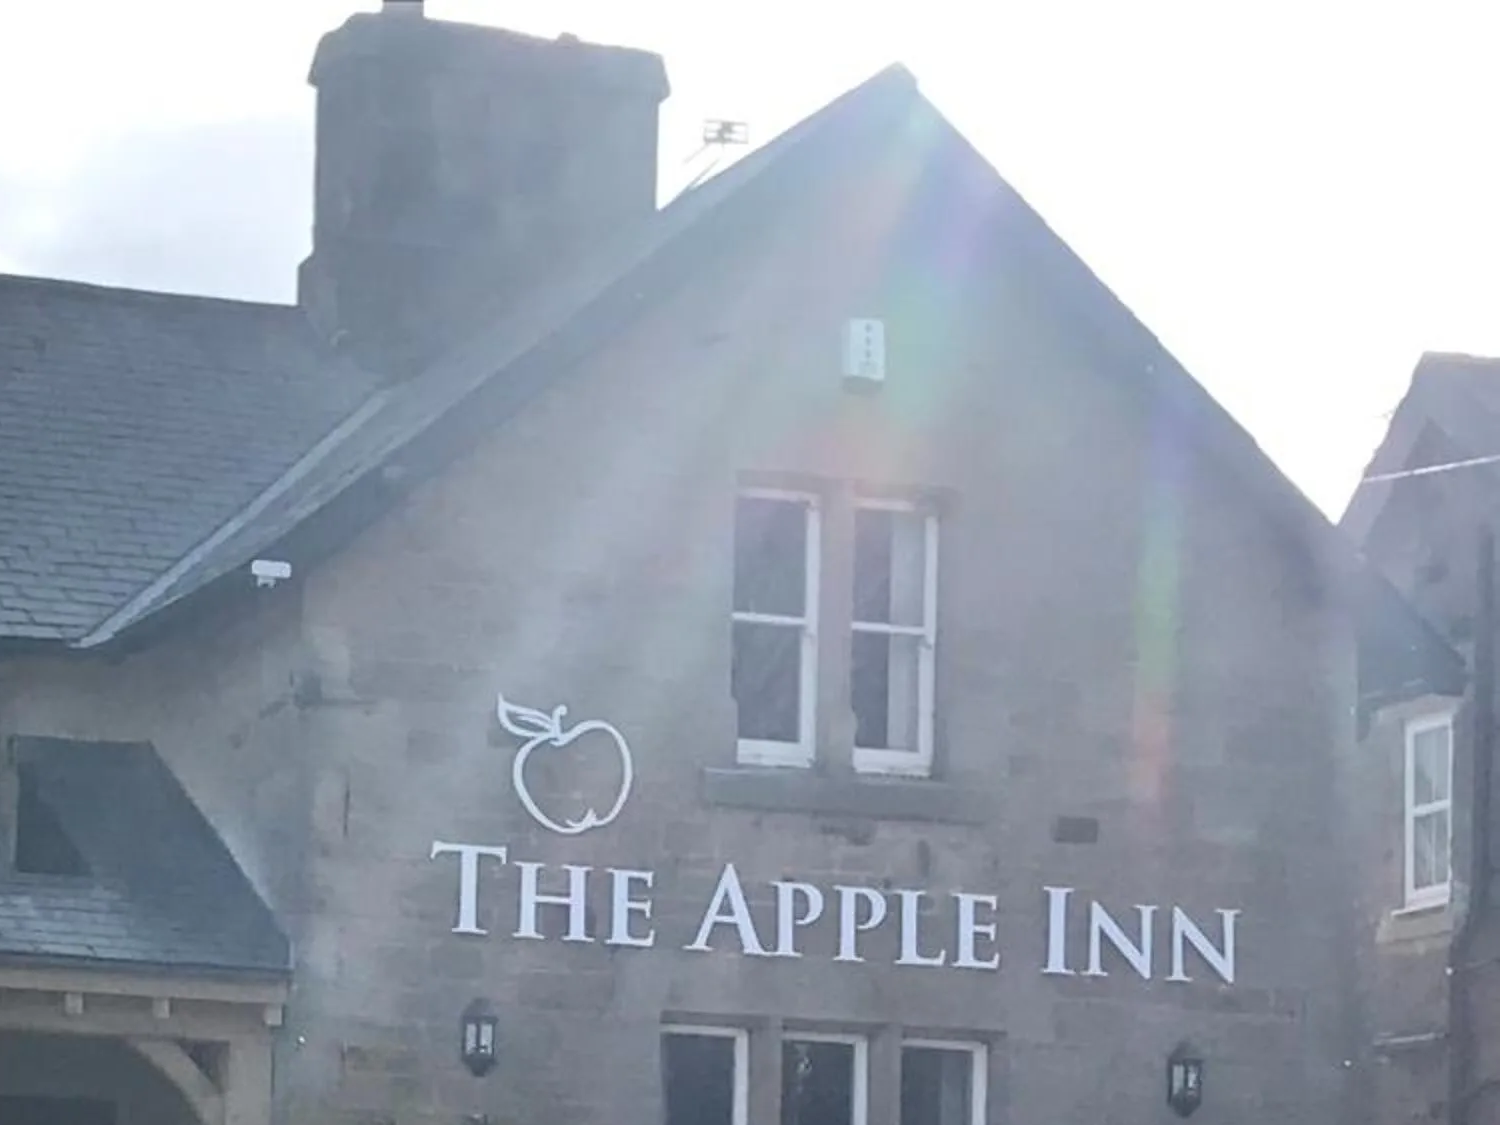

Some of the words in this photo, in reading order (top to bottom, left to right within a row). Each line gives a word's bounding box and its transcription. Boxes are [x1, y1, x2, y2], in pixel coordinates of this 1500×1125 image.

[431, 840, 655, 947] THE
[682, 862, 1002, 970] APPLE
[1041, 886, 1242, 984] INN
